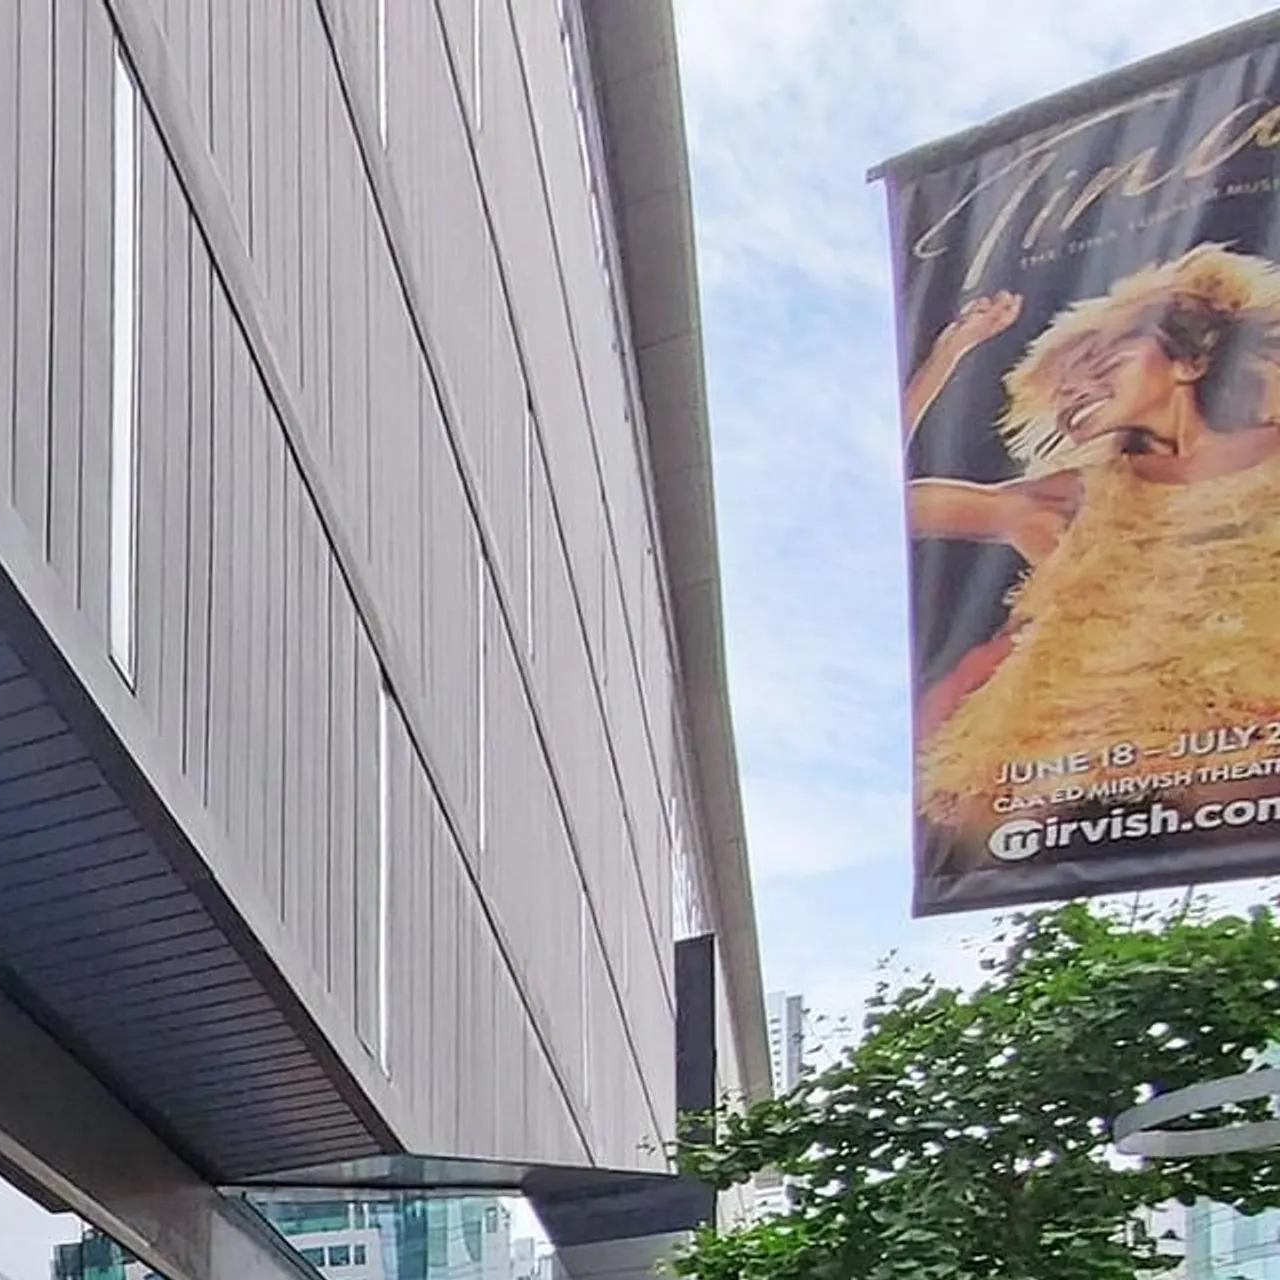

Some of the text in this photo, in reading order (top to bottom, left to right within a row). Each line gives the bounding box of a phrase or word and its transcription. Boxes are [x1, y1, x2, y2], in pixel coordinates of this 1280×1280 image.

[995, 750, 1091, 785] JUNE
[1101, 742, 1136, 768] 18
[1167, 725, 1258, 759] JULY
[1054, 786, 1085, 803] ED
[1088, 770, 1192, 801] MIRVISH
